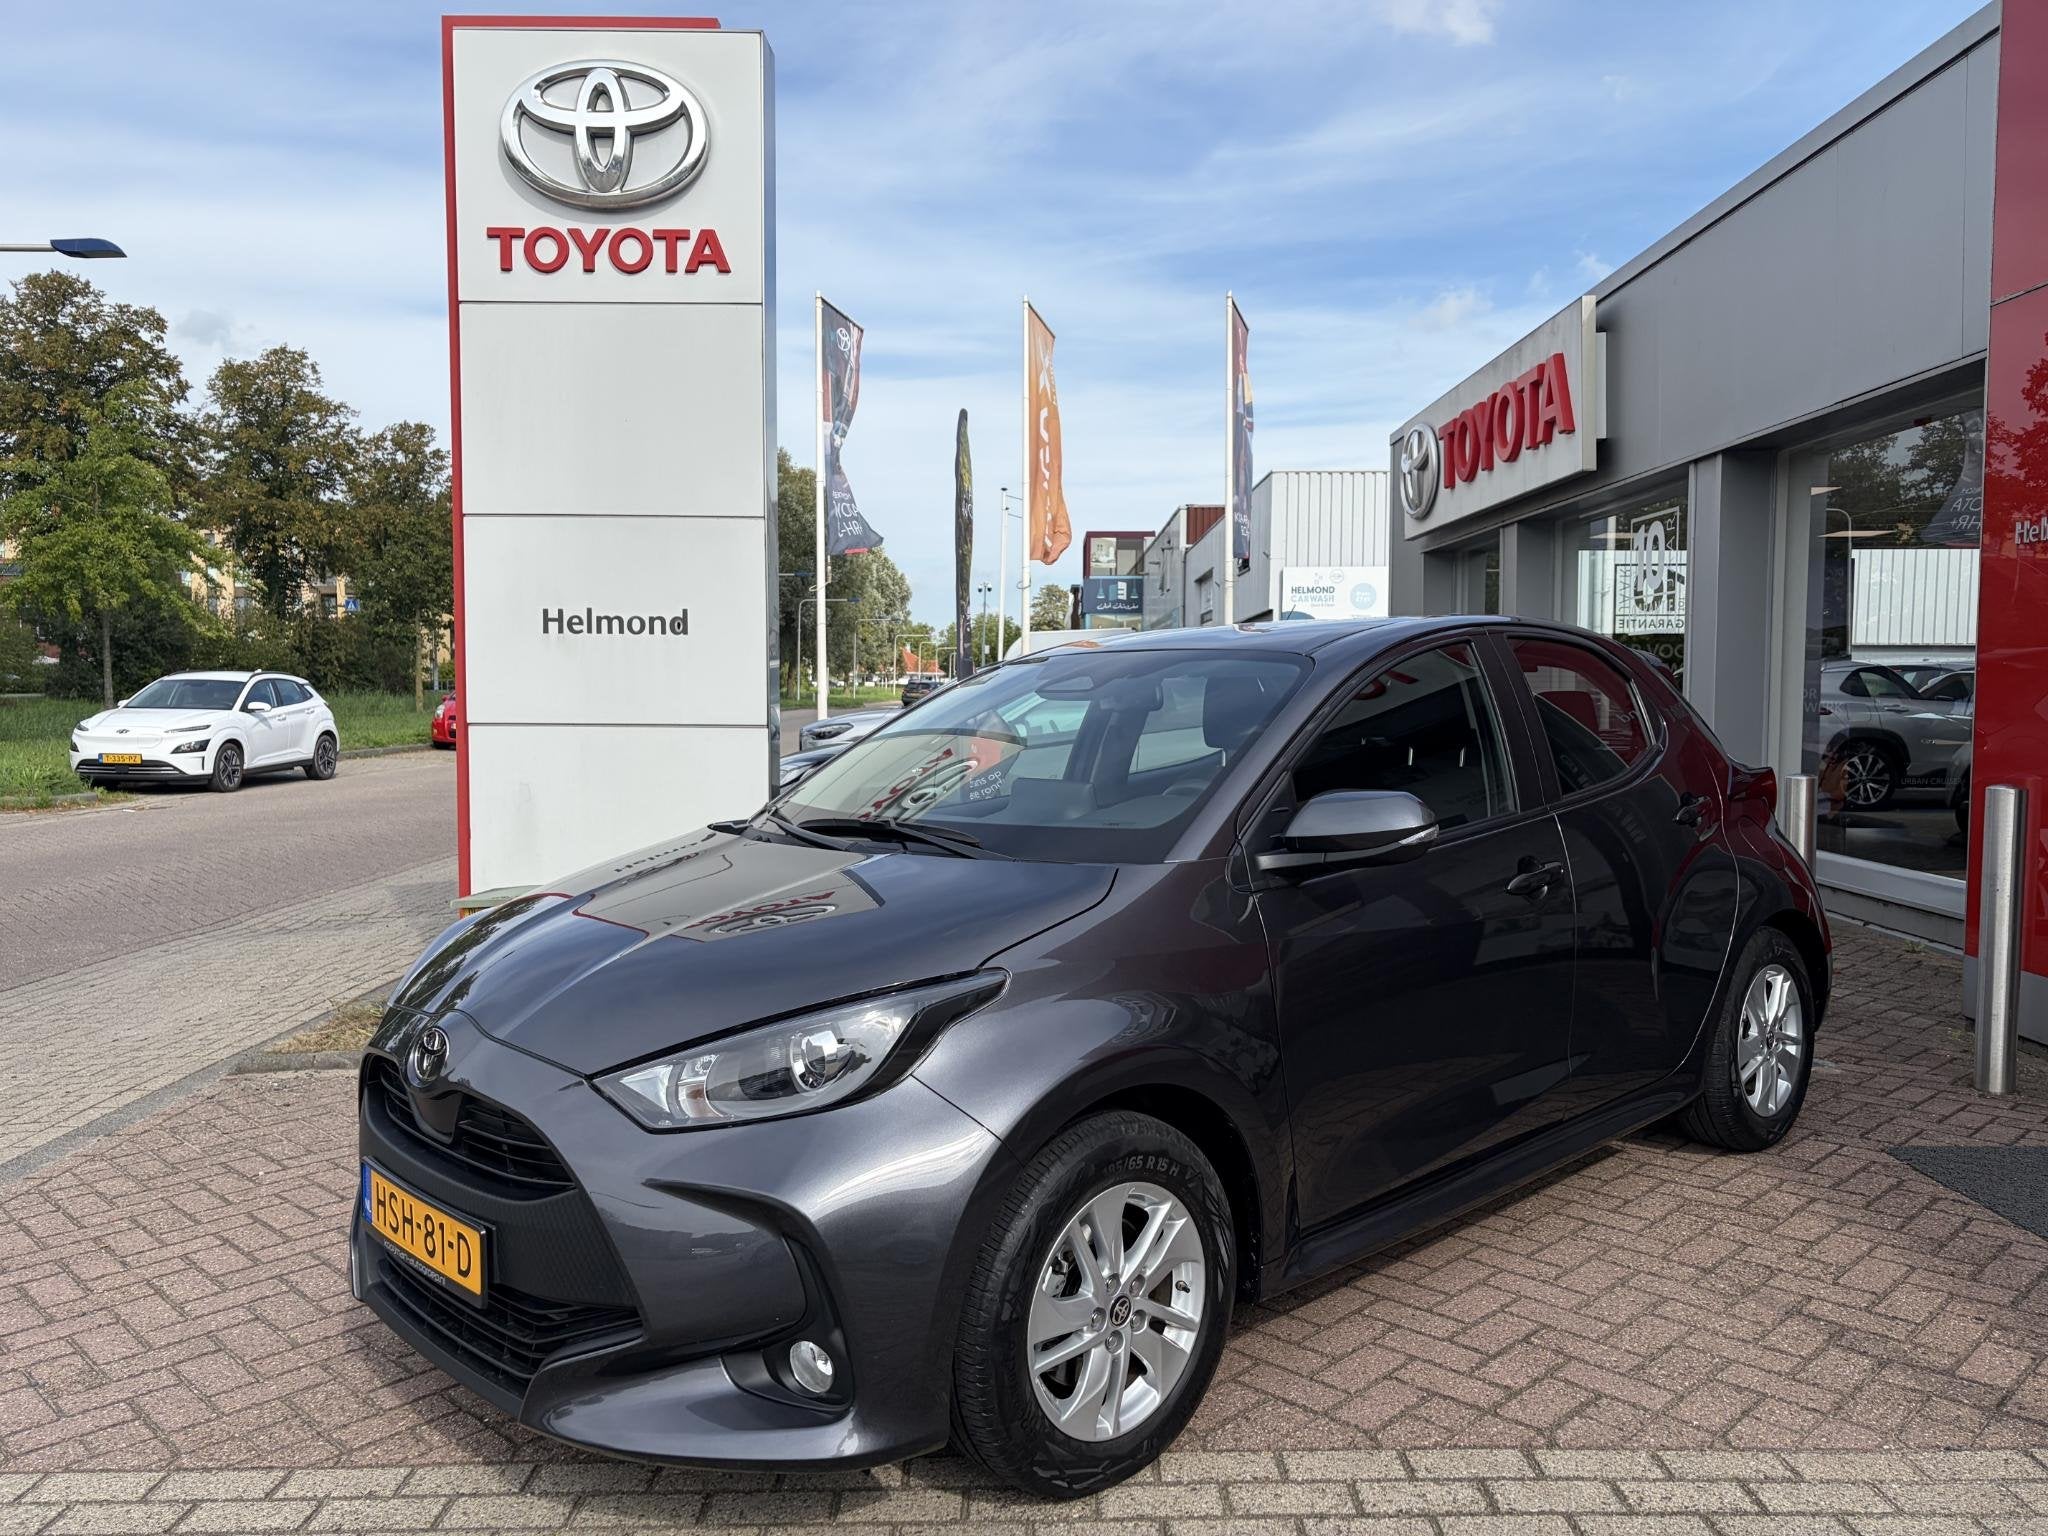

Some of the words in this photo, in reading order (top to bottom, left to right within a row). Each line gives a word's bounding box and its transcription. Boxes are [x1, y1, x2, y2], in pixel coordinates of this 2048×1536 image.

[487, 227, 732, 274] TOYOTA
[1438, 352, 1576, 490] TOYOTA
[2015, 516, 2048, 545] Hel
[1291, 586, 1335, 594] HELMOND
[1291, 595, 1335, 603] CARWASH
[542, 607, 688, 635] Helmond
[105, 755, 138, 763] T-335-PZ
[376, 1181, 472, 1279] HSH-81-D
